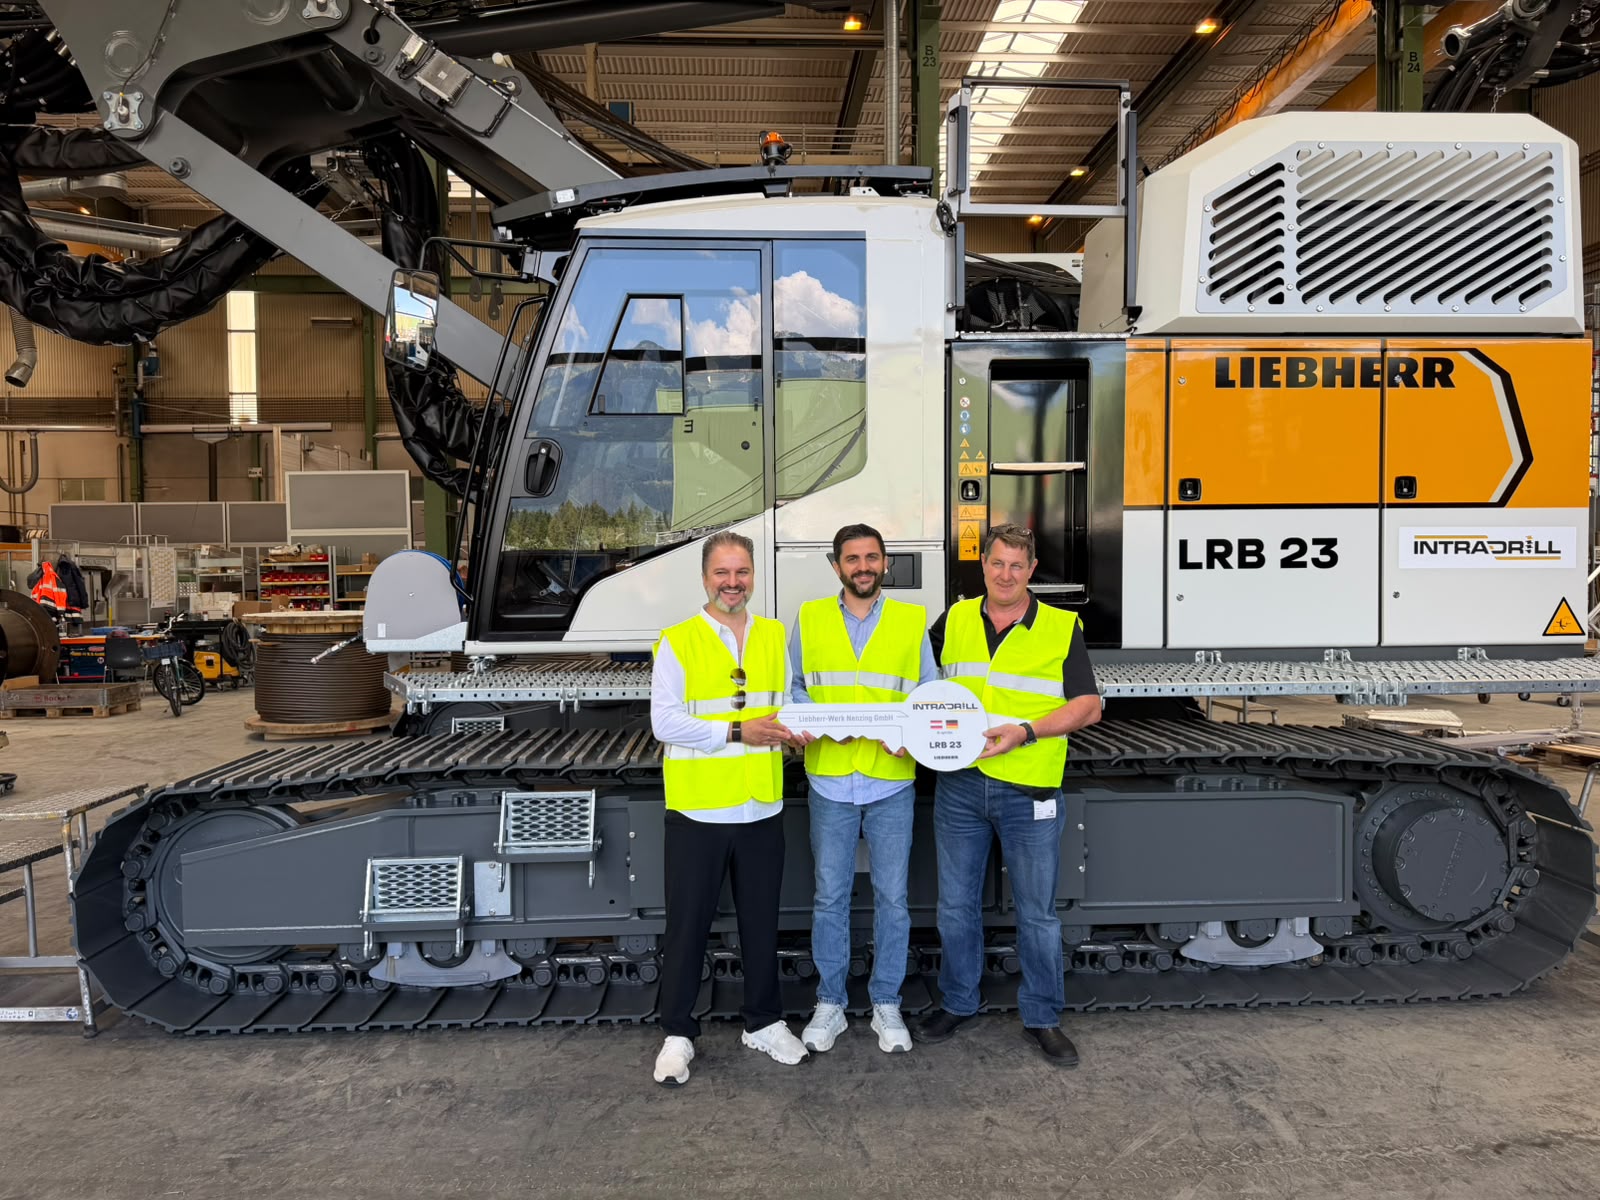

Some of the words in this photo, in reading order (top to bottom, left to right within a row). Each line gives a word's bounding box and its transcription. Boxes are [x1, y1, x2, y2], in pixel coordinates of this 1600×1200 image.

[925, 45, 934, 56] B
[922, 56, 937, 67] 23
[1409, 51, 1418, 62] B
[1407, 62, 1420, 73] 24
[1215, 356, 1456, 389] LIEBHERR
[1413, 536, 1562, 555] INTRADRILL
[1179, 538, 1266, 570] LRB
[1280, 537, 1339, 569] 23
[912, 702, 979, 711] INTRADRILL
[798, 714, 845, 723] Liebherr-Werk
[846, 714, 873, 723] Nenzing
[874, 714, 894, 722] GmbH
[929, 741, 948, 749] LRB
[949, 741, 962, 749] 23
